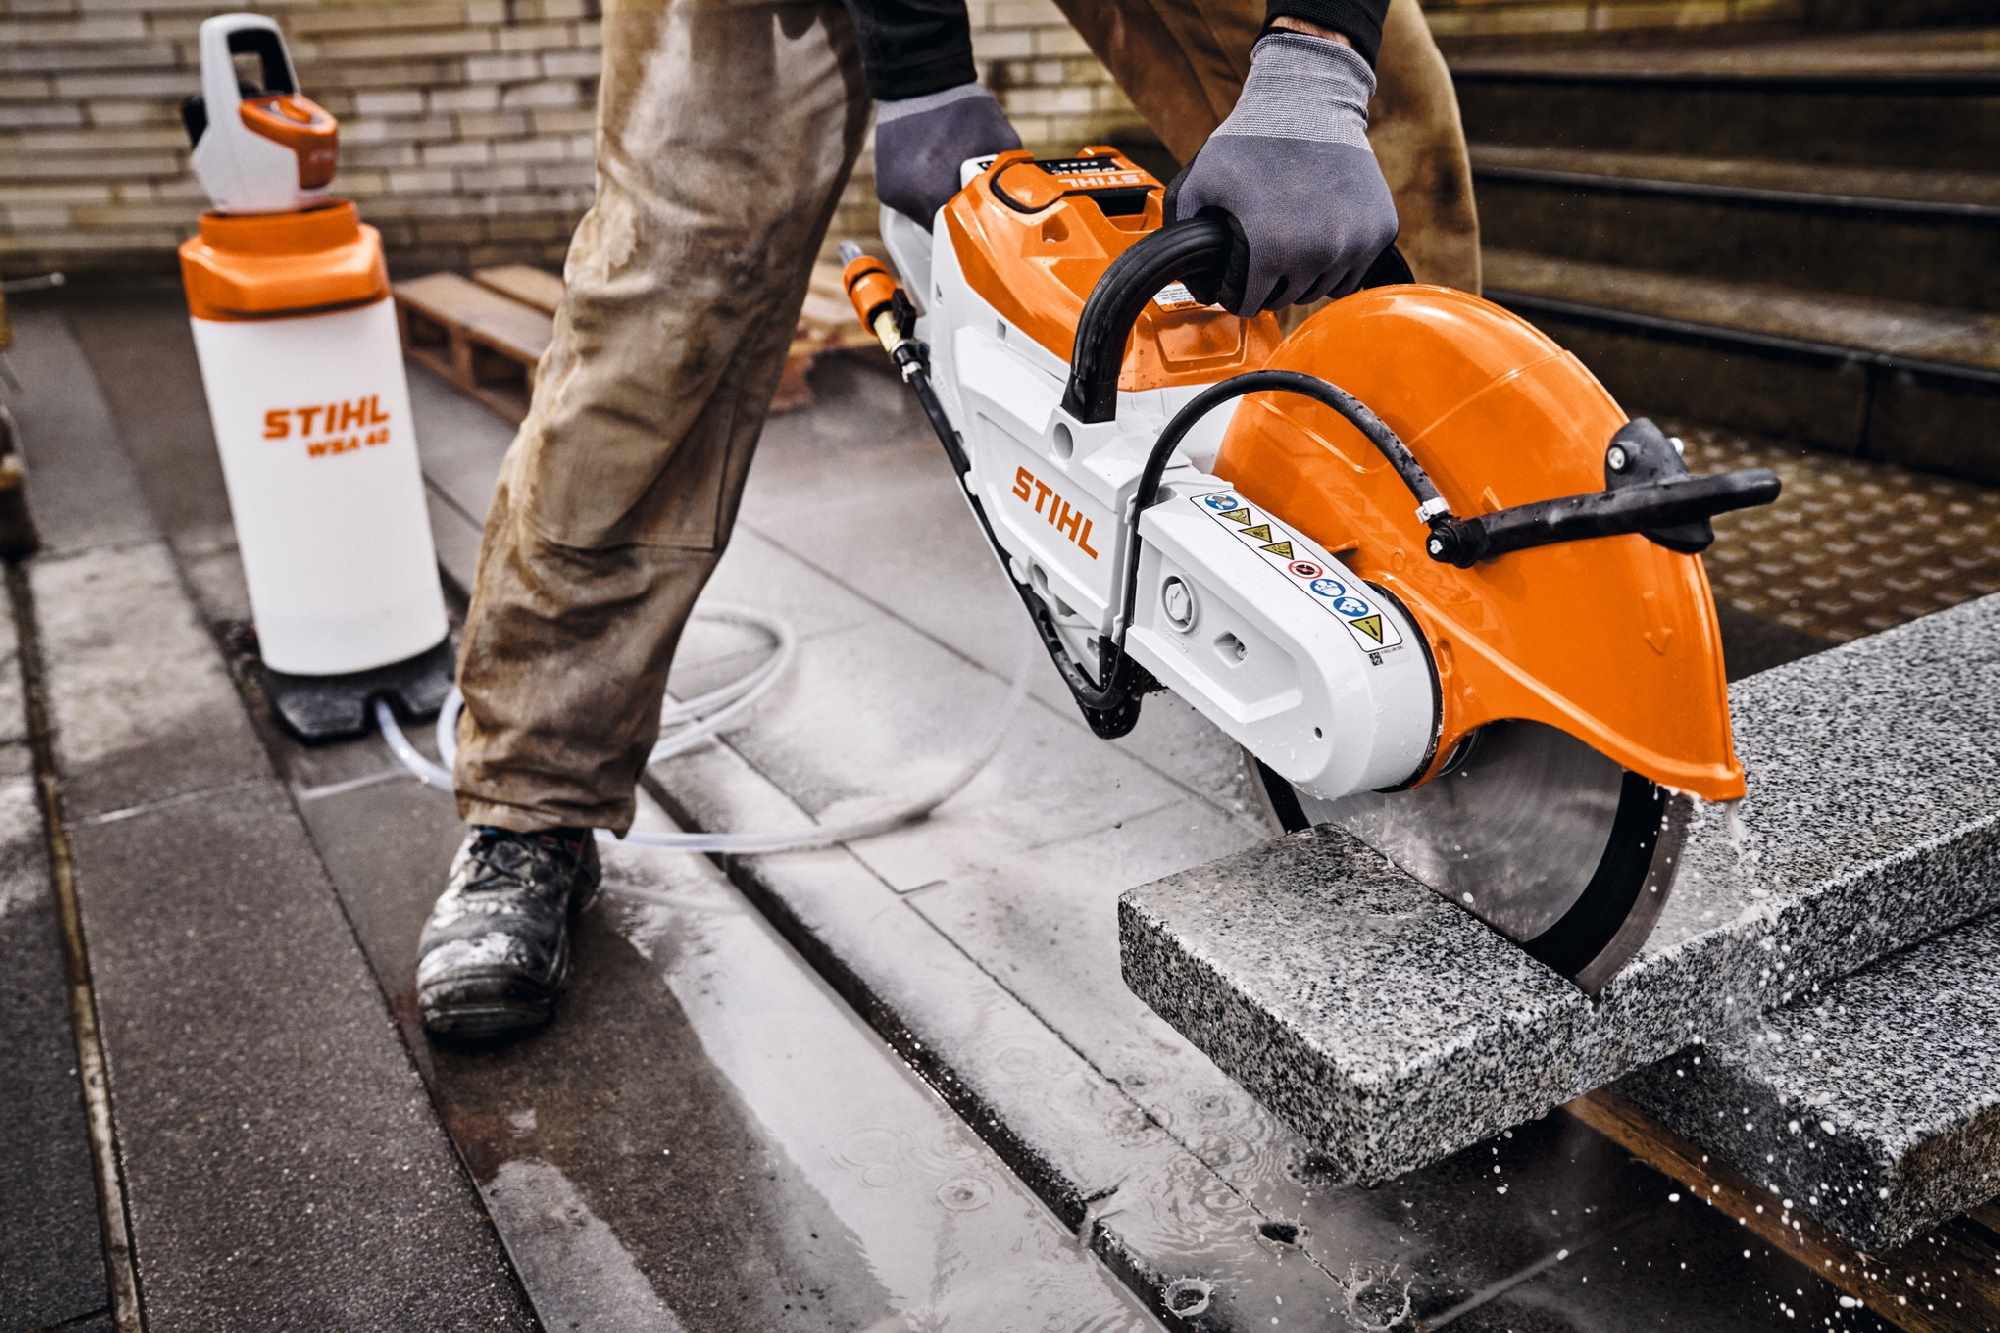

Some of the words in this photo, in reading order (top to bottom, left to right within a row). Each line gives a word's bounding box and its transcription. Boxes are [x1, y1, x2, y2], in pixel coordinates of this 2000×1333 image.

[1058, 173, 1141, 188] STIHL
[264, 394, 390, 439] STIHL
[307, 436, 359, 458] WSA
[1012, 465, 1099, 560] STIHL
